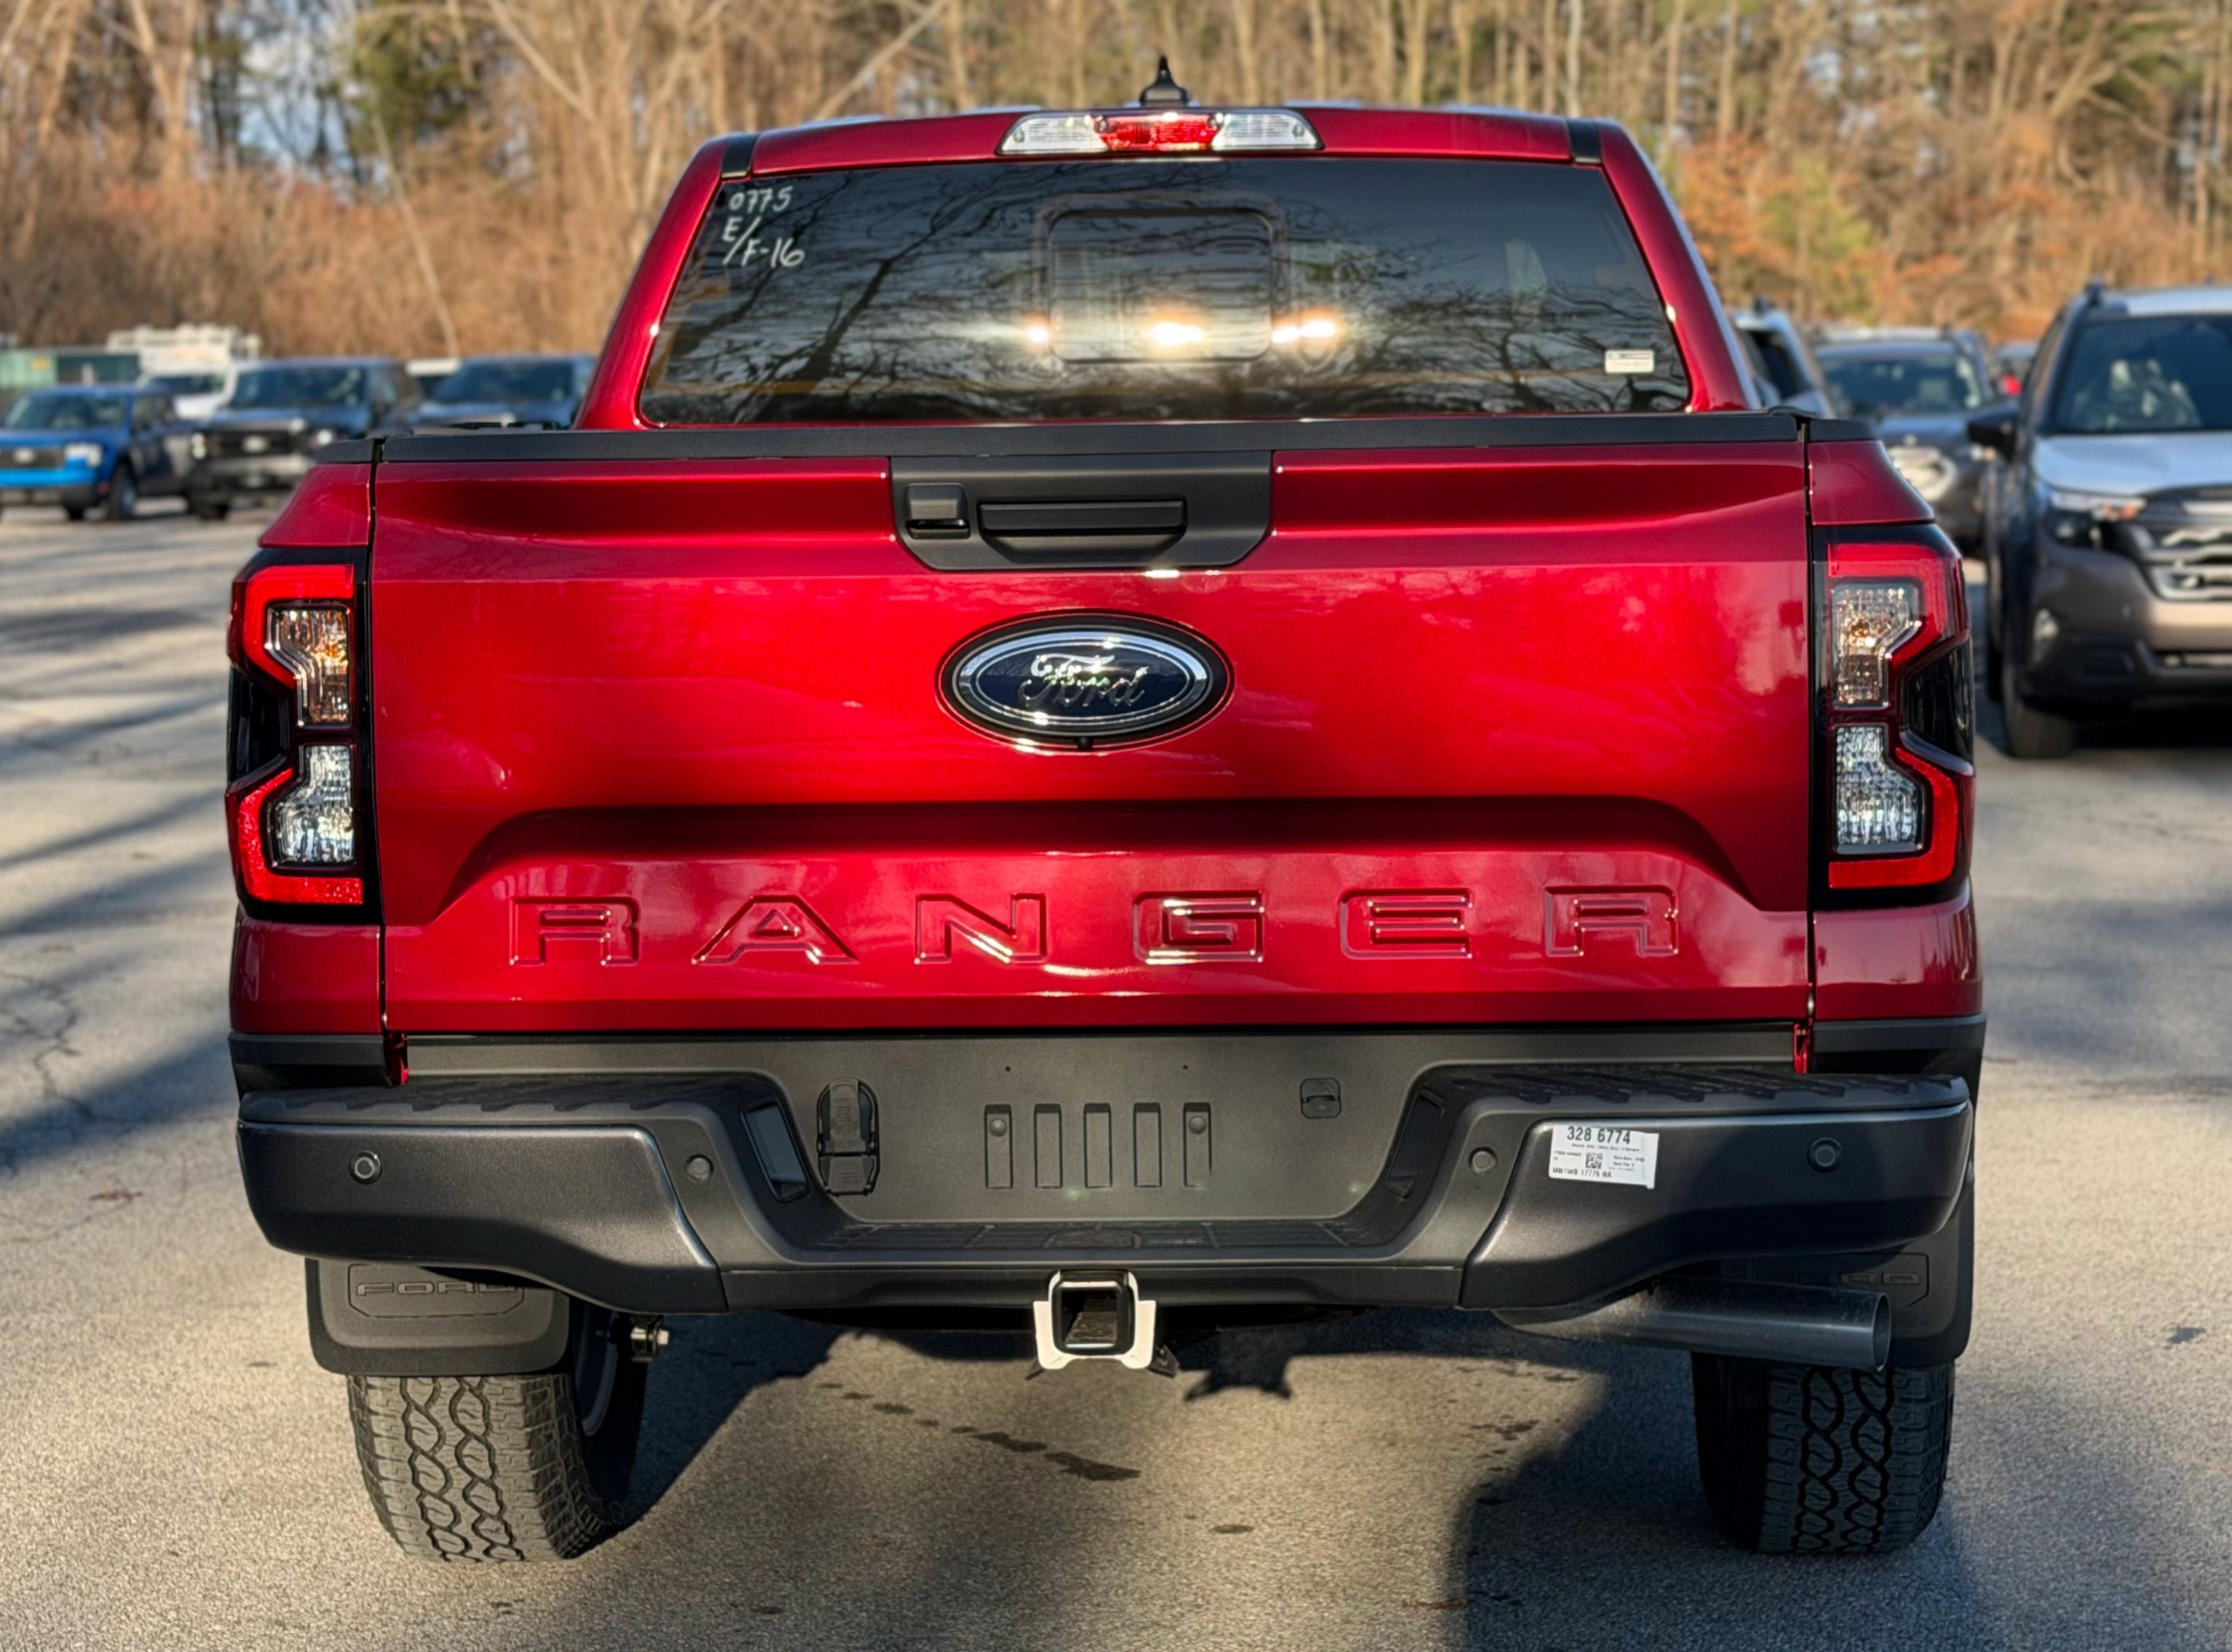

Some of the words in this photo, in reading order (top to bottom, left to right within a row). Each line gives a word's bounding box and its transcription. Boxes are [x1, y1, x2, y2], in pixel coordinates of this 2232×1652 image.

[728, 185, 793, 213] 0775
[1018, 653, 1149, 707] Ford
[509, 885, 1680, 966] RANGER
[1566, 1125, 1592, 1141] 328
[1597, 1127, 1631, 1145] 6774
